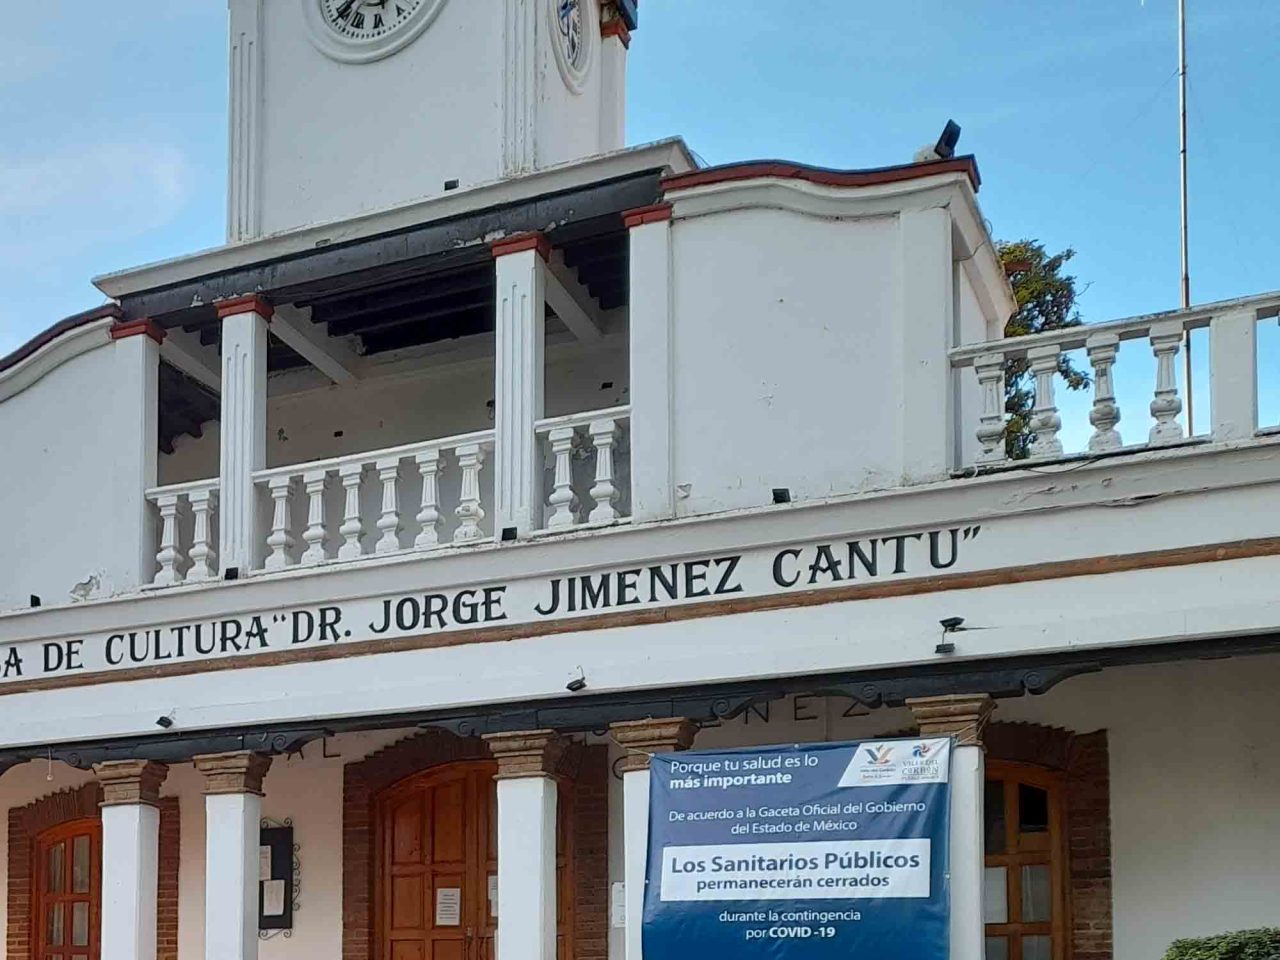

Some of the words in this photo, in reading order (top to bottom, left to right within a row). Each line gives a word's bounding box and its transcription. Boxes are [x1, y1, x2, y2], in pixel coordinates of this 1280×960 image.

[43, 639, 84, 672] DE
[105, 615, 270, 665] CULTURA
[369, 586, 508, 634] JORGE
[534, 555, 743, 616] JIMENEZ
[671, 759, 720, 774] Porque
[725, 759, 739, 771] tu
[743, 757, 781, 770] salud
[785, 757, 800, 768] es
[805, 755, 818, 767] lo
[670, 774, 701, 788] más
[704, 772, 792, 789] importante
[669, 810, 684, 821] De
[686, 807, 733, 819] acuerdo
[736, 810, 743, 818] a
[746, 806, 756, 817] la
[759, 805, 799, 818] Gaceta
[803, 803, 841, 816] Oficial
[844, 803, 862, 814] del
[866, 801, 925, 813] Gobierno
[731, 823, 749, 834] del
[752, 821, 792, 833] Estado
[795, 821, 809, 832] de
[813, 818, 857, 831] México
[672, 857, 706, 873] Los
[711, 854, 818, 872] Sanitarios
[824, 852, 920, 870] Públicos
[697, 877, 812, 892] permanecerán
[817, 874, 889, 887] cerrados
[719, 911, 766, 922] durante
[769, 911, 778, 921] la
[782, 910, 860, 924] contingencia
[746, 929, 767, 940] por
[769, 927, 811, 938] COVID
[814, 927, 835, 938] -19
